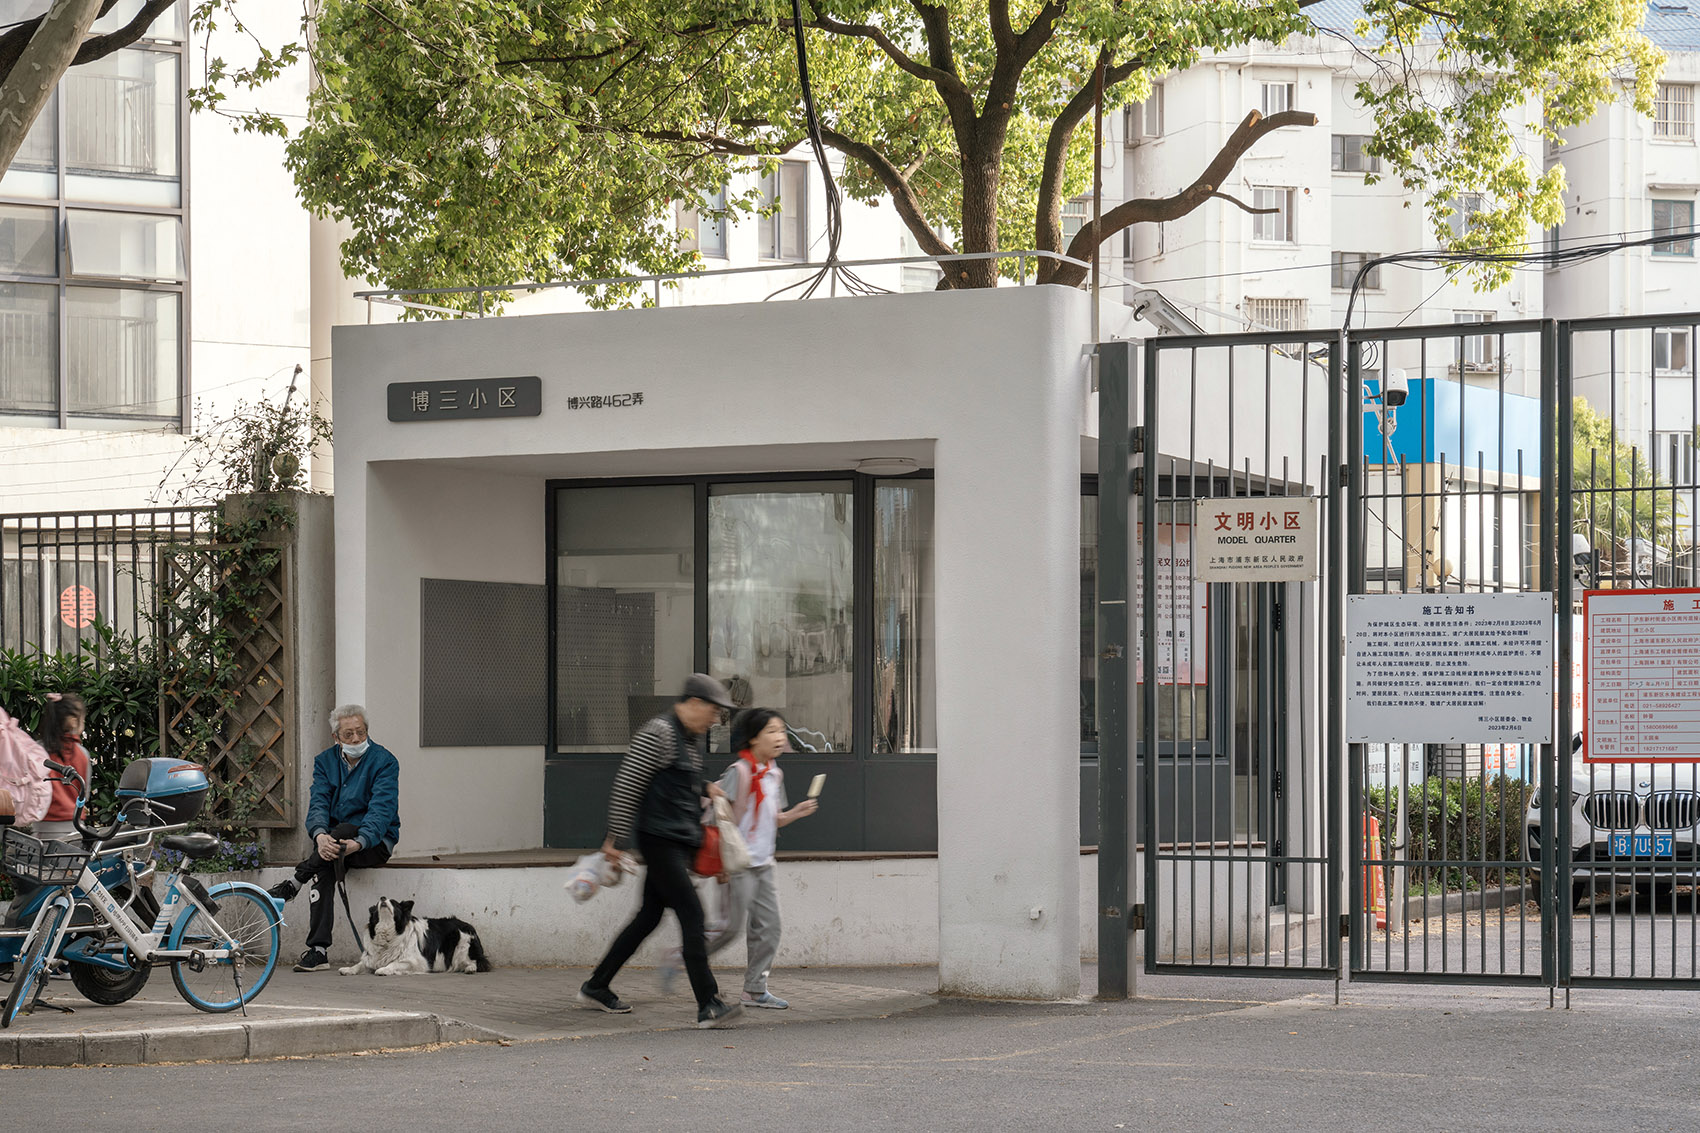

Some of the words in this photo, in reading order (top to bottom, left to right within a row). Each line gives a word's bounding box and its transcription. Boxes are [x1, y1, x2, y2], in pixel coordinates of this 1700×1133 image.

[411, 386, 516, 412] 博三小区
[567, 392, 644, 410] 博兴路462弄
[1214, 511, 1300, 531] 文明小区
[1217, 536, 1248, 544] MODEL
[1254, 535, 1296, 544] QUARTER
[1209, 555, 1304, 564] 上海市浦东新区人民政府
[1422, 605, 1475, 615] 施工告知书
